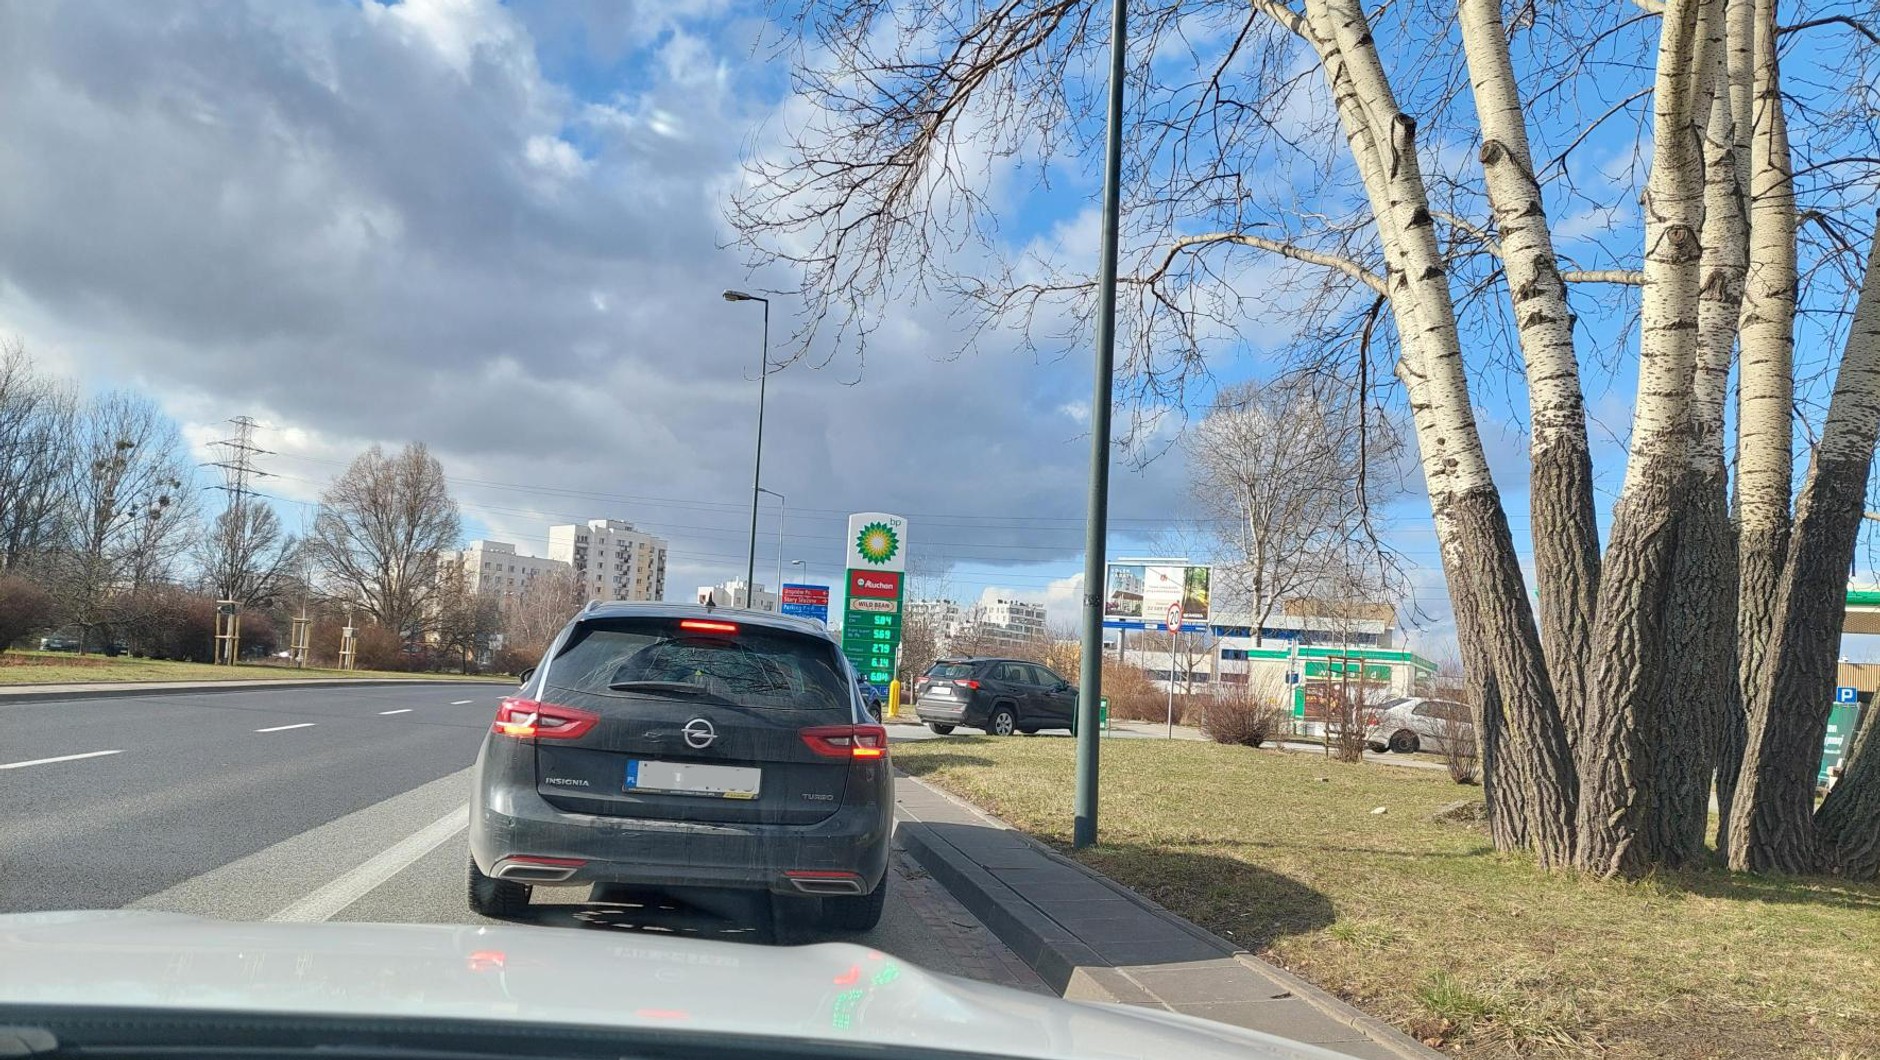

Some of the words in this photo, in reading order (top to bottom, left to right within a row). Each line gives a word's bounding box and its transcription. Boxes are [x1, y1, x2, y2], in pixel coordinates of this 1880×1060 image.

[890, 518, 902, 527] bp
[865, 580, 894, 590] Auchan
[1169, 610, 1179, 625] 20
[1841, 689, 1853, 702] P
[545, 777, 590, 787] INSIGNIA
[626, 776, 635, 784] PL
[801, 793, 834, 801] TURBO
